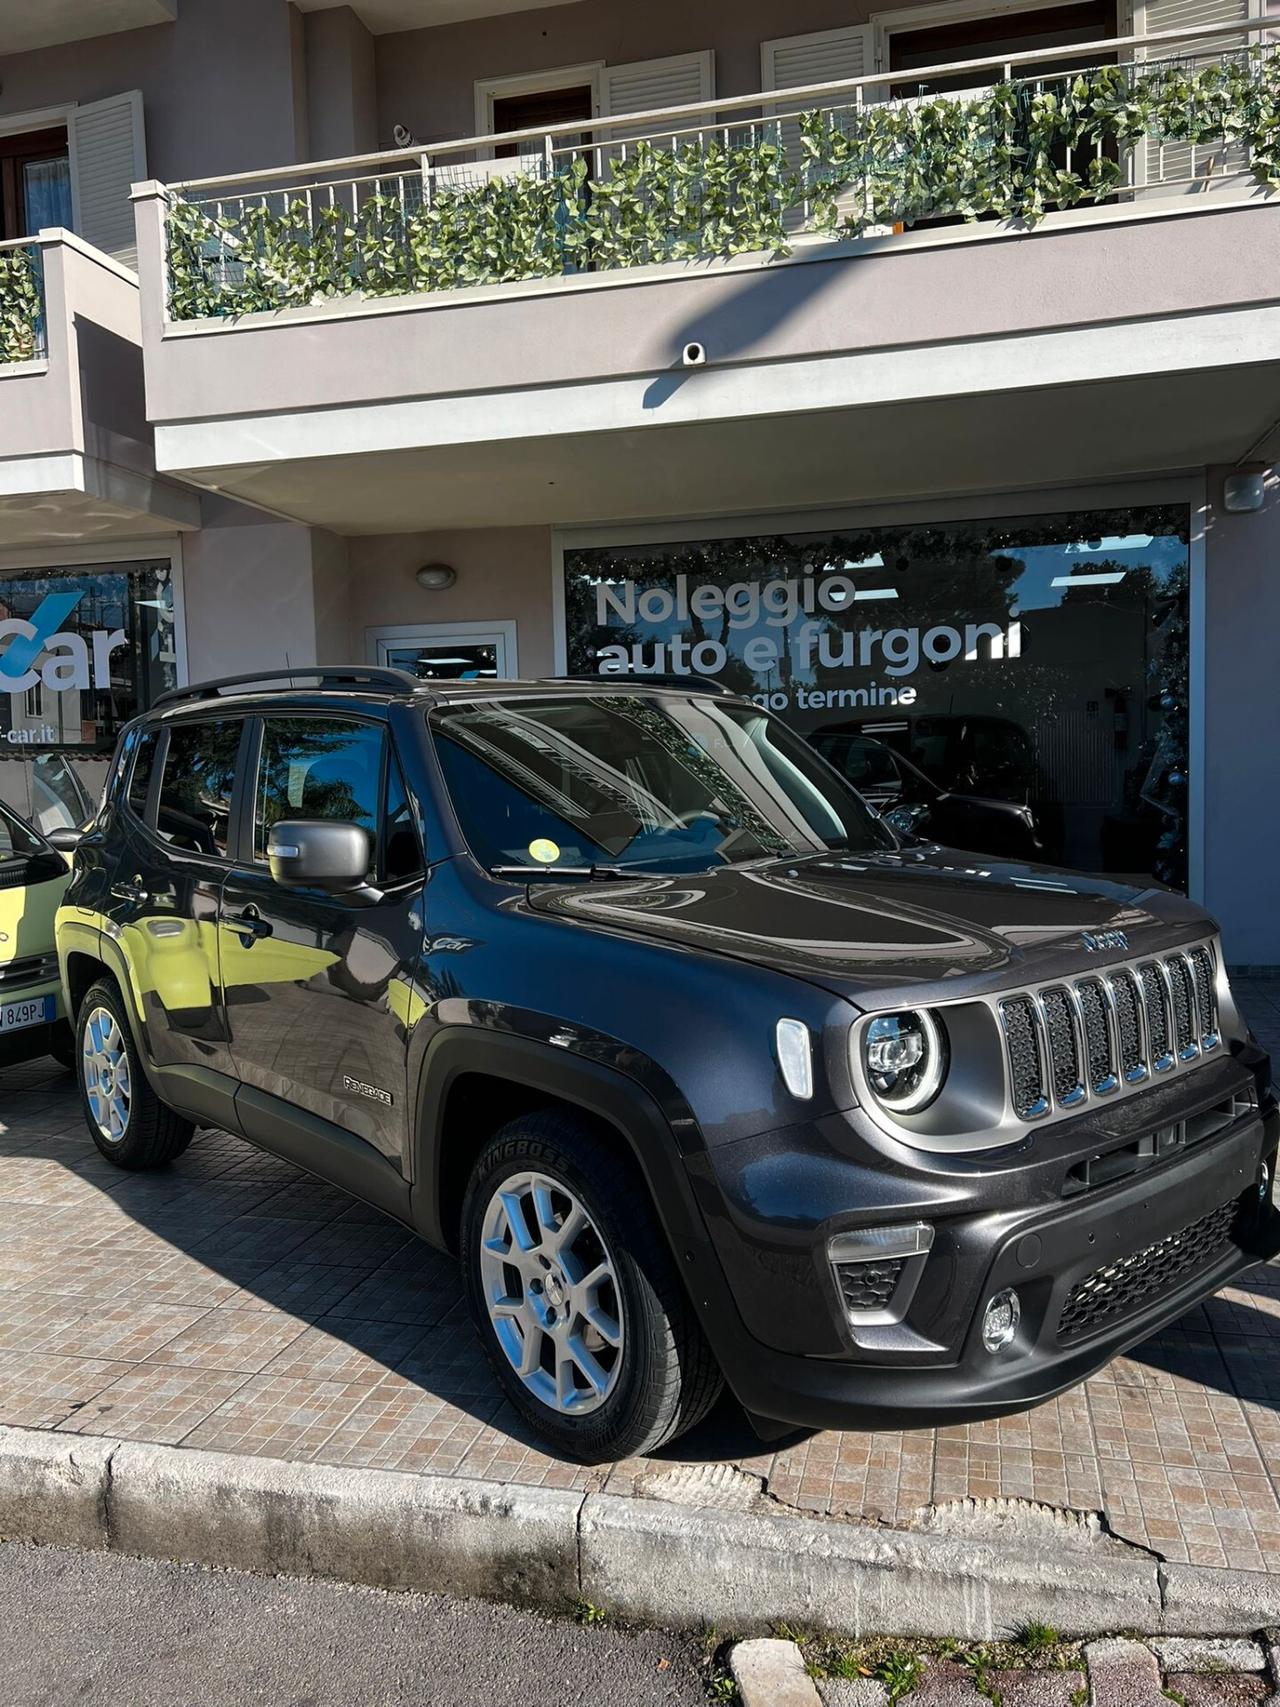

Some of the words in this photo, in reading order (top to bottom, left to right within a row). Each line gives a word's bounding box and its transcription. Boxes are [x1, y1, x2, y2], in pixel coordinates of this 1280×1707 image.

[596, 564, 856, 631] Noleggio
[598, 634, 727, 675] auto
[743, 635, 778, 672] e
[796, 607, 1022, 676] furgoni
[796, 681, 917, 709] termine
[0, 724, 54, 744] -car.it
[1081, 930, 1129, 952] Jeep
